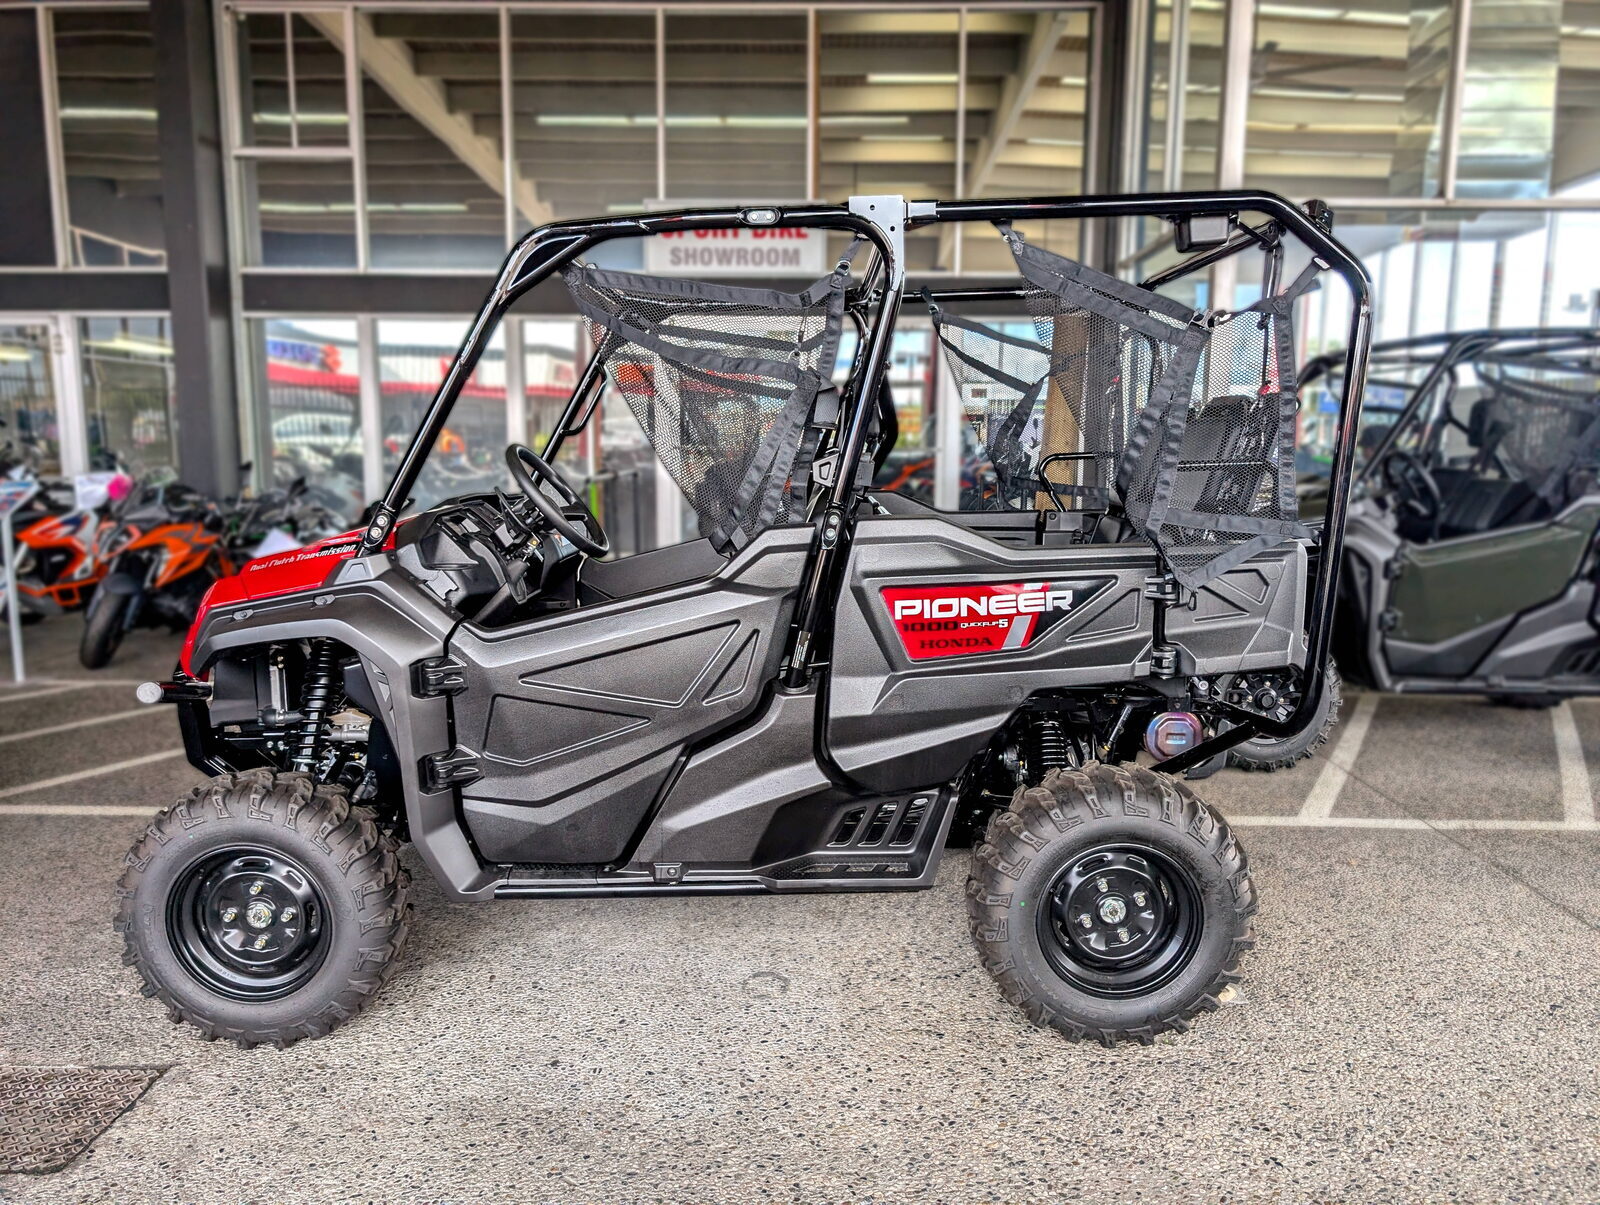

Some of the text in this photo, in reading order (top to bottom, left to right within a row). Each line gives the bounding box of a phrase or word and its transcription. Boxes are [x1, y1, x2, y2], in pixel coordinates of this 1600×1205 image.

[670, 246, 801, 267] SHOWROOM
[296, 544, 357, 562] Transmission
[894, 590, 1073, 620] PIONEER
[903, 621, 959, 632] 1000
[920, 637, 994, 649] HONDA
